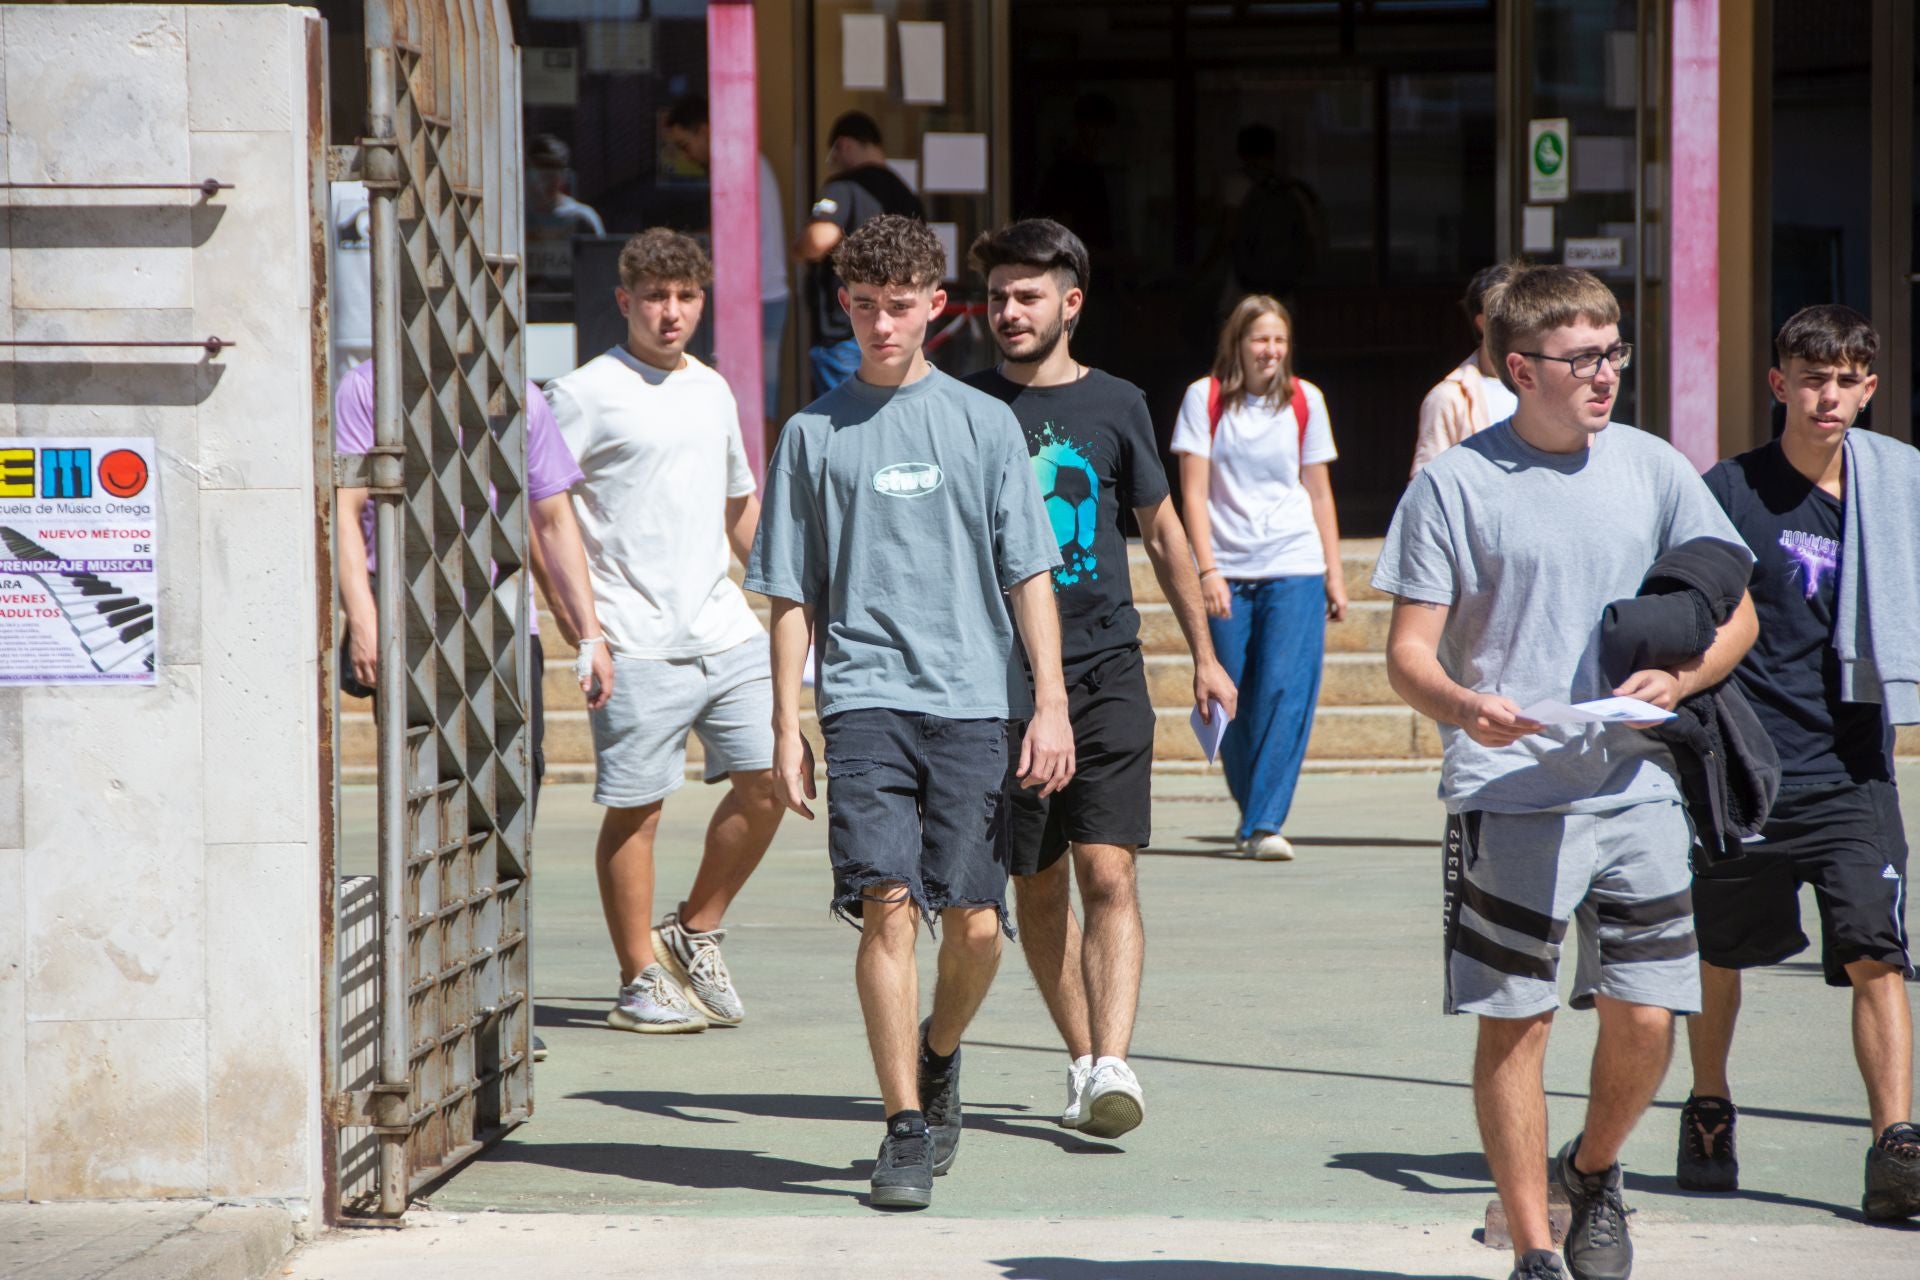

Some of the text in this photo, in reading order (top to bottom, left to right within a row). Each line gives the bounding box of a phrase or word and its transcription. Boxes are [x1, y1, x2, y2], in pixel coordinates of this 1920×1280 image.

[35, 503, 53, 514] de
[57, 503, 101, 514] Música
[105, 503, 150, 516] Ortega
[39, 527, 151, 539] NUEVO MÉTODO
[133, 544, 150, 553] DE
[88, 559, 151, 570] MUSICAL
[0, 579, 22, 588] RA
[0, 594, 46, 603] VENES
[0, 608, 60, 618] ADULTOS
[1447, 829, 1460, 881] 0342
